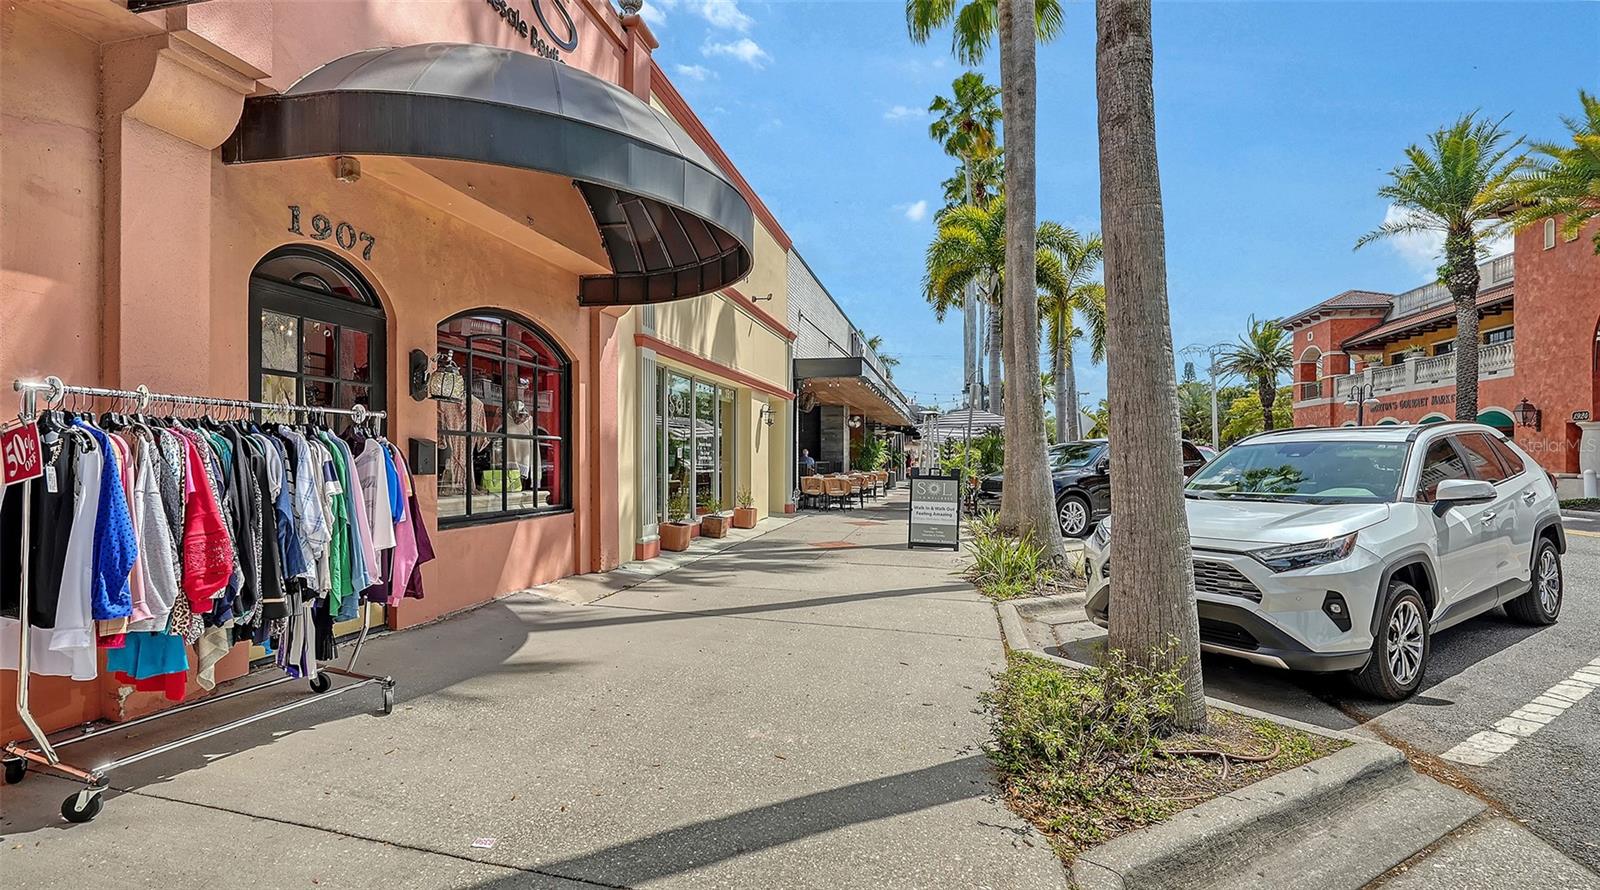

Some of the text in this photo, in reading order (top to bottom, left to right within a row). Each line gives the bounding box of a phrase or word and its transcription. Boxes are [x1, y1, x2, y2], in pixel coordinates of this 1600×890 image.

[288, 205, 375, 261] 1907
[6, 433, 35, 478] 50%
[25, 451, 37, 472] OFF
[917, 481, 952, 496] SOL
